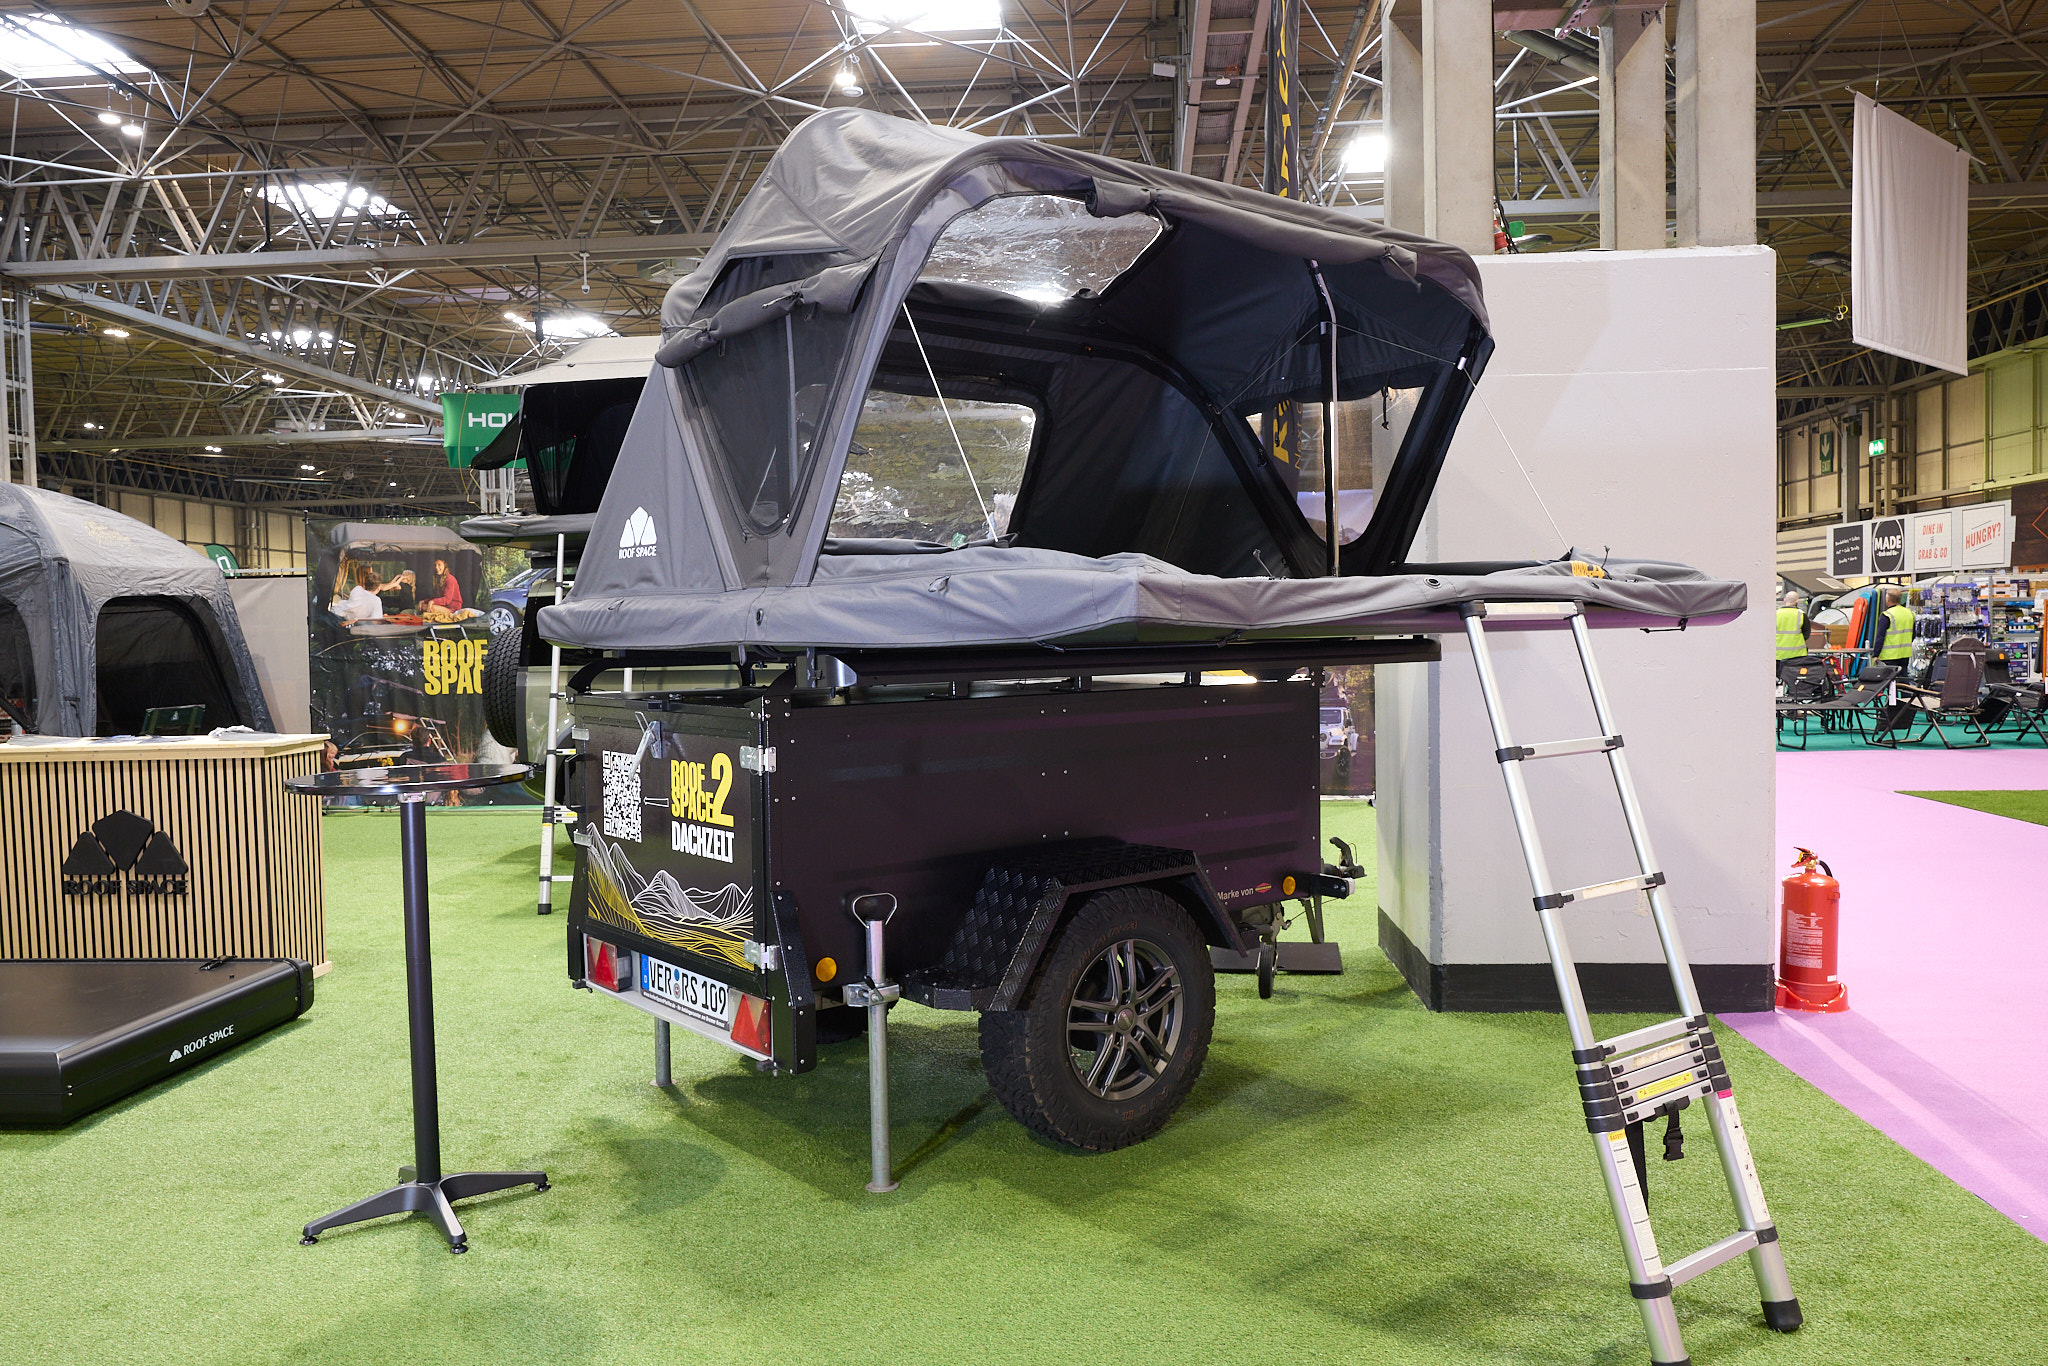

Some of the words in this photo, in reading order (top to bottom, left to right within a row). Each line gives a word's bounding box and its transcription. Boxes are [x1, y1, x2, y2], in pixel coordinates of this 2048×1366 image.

[1923, 524, 1935, 535] DINE
[1937, 522, 1943, 534] IN
[1965, 522, 2001, 549] HUNGRY?
[619, 547, 635, 559] ROOF
[636, 546, 656, 557] SPACE
[1874, 535, 1901, 551] MADE
[1918, 548, 1932, 560] GRAB
[1934, 548, 1938, 559] &
[1940, 547, 1948, 558] GO
[423, 639, 488, 676] ROOF
[671, 760, 705, 798] ROOF
[671, 788, 714, 823] SPACE
[711, 752, 734, 828] 2
[671, 820, 735, 864] DACHZELT
[64, 880, 121, 895] ROOF
[127, 880, 189, 895] SPACE
[1217, 889, 1239, 901] Marke
[1240, 887, 1254, 896] von
[649, 960, 672, 995] VER
[682, 972, 698, 1005] RS
[701, 981, 727, 1015] 109
[183, 1036, 207, 1056] ROOF
[208, 1024, 235, 1044] SPACE
